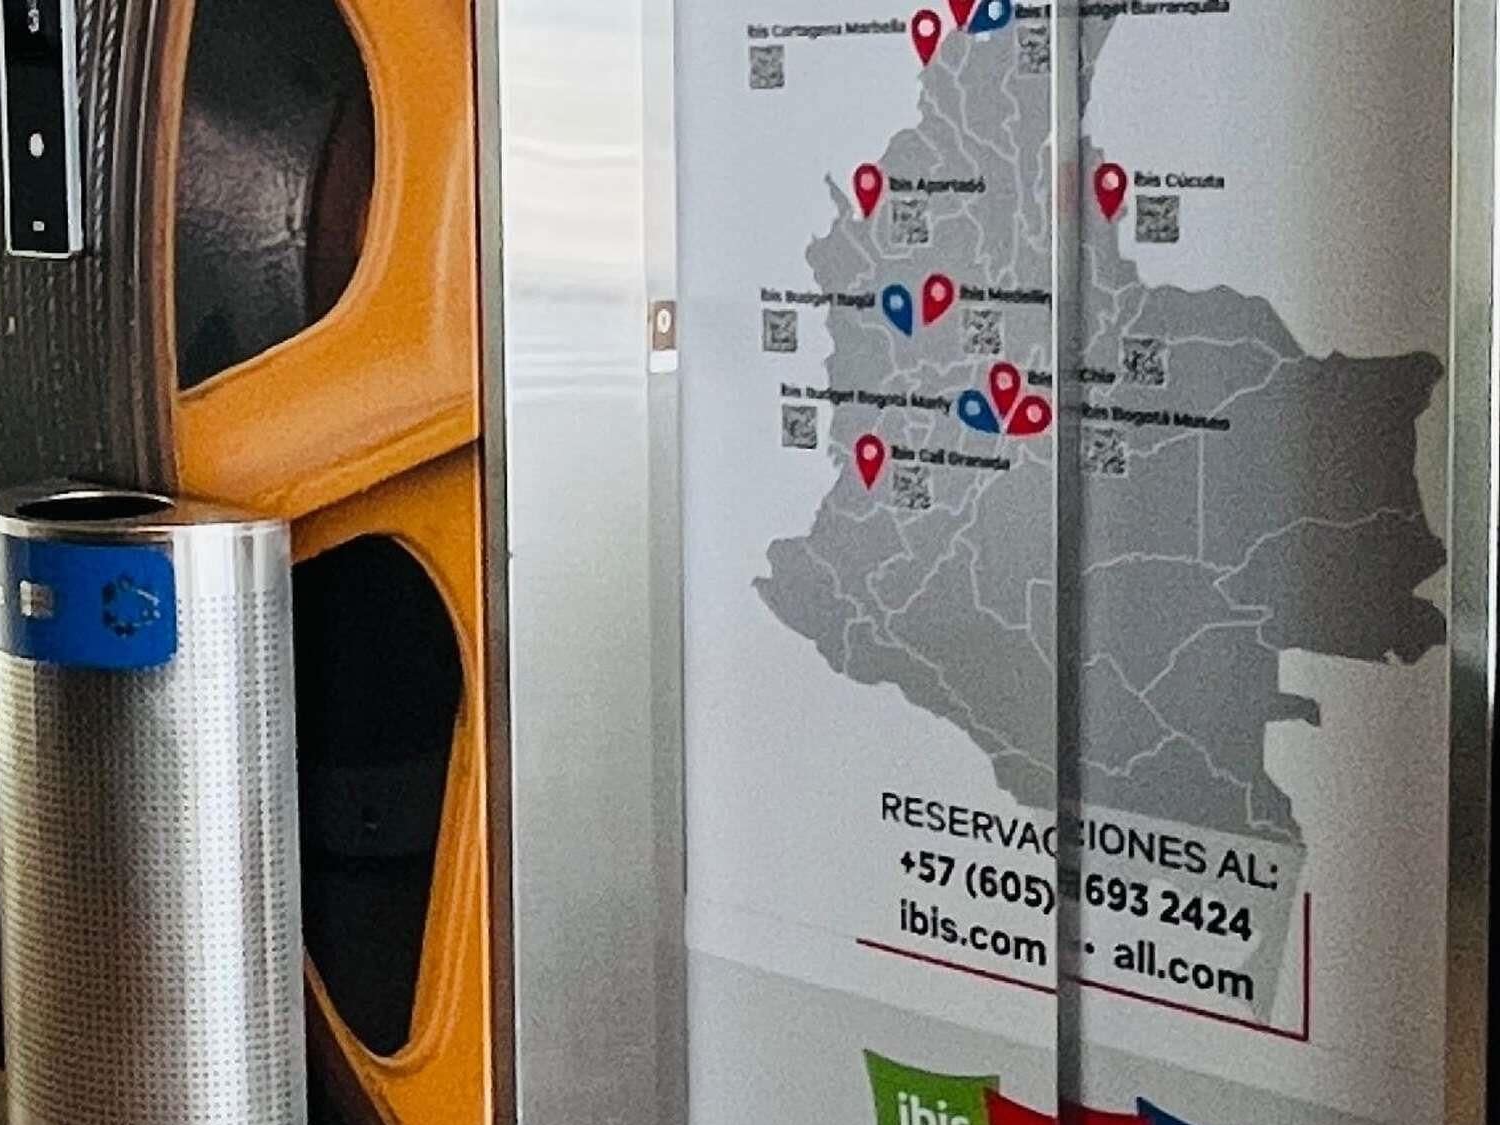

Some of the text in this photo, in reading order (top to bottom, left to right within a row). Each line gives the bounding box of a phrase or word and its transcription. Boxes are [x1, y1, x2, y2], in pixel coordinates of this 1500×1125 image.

[900, 850, 1252, 941] +57 (605) 693 2424
[1217, 850, 1279, 890] AL:
[900, 898, 1254, 1000] ibis.com all.com
